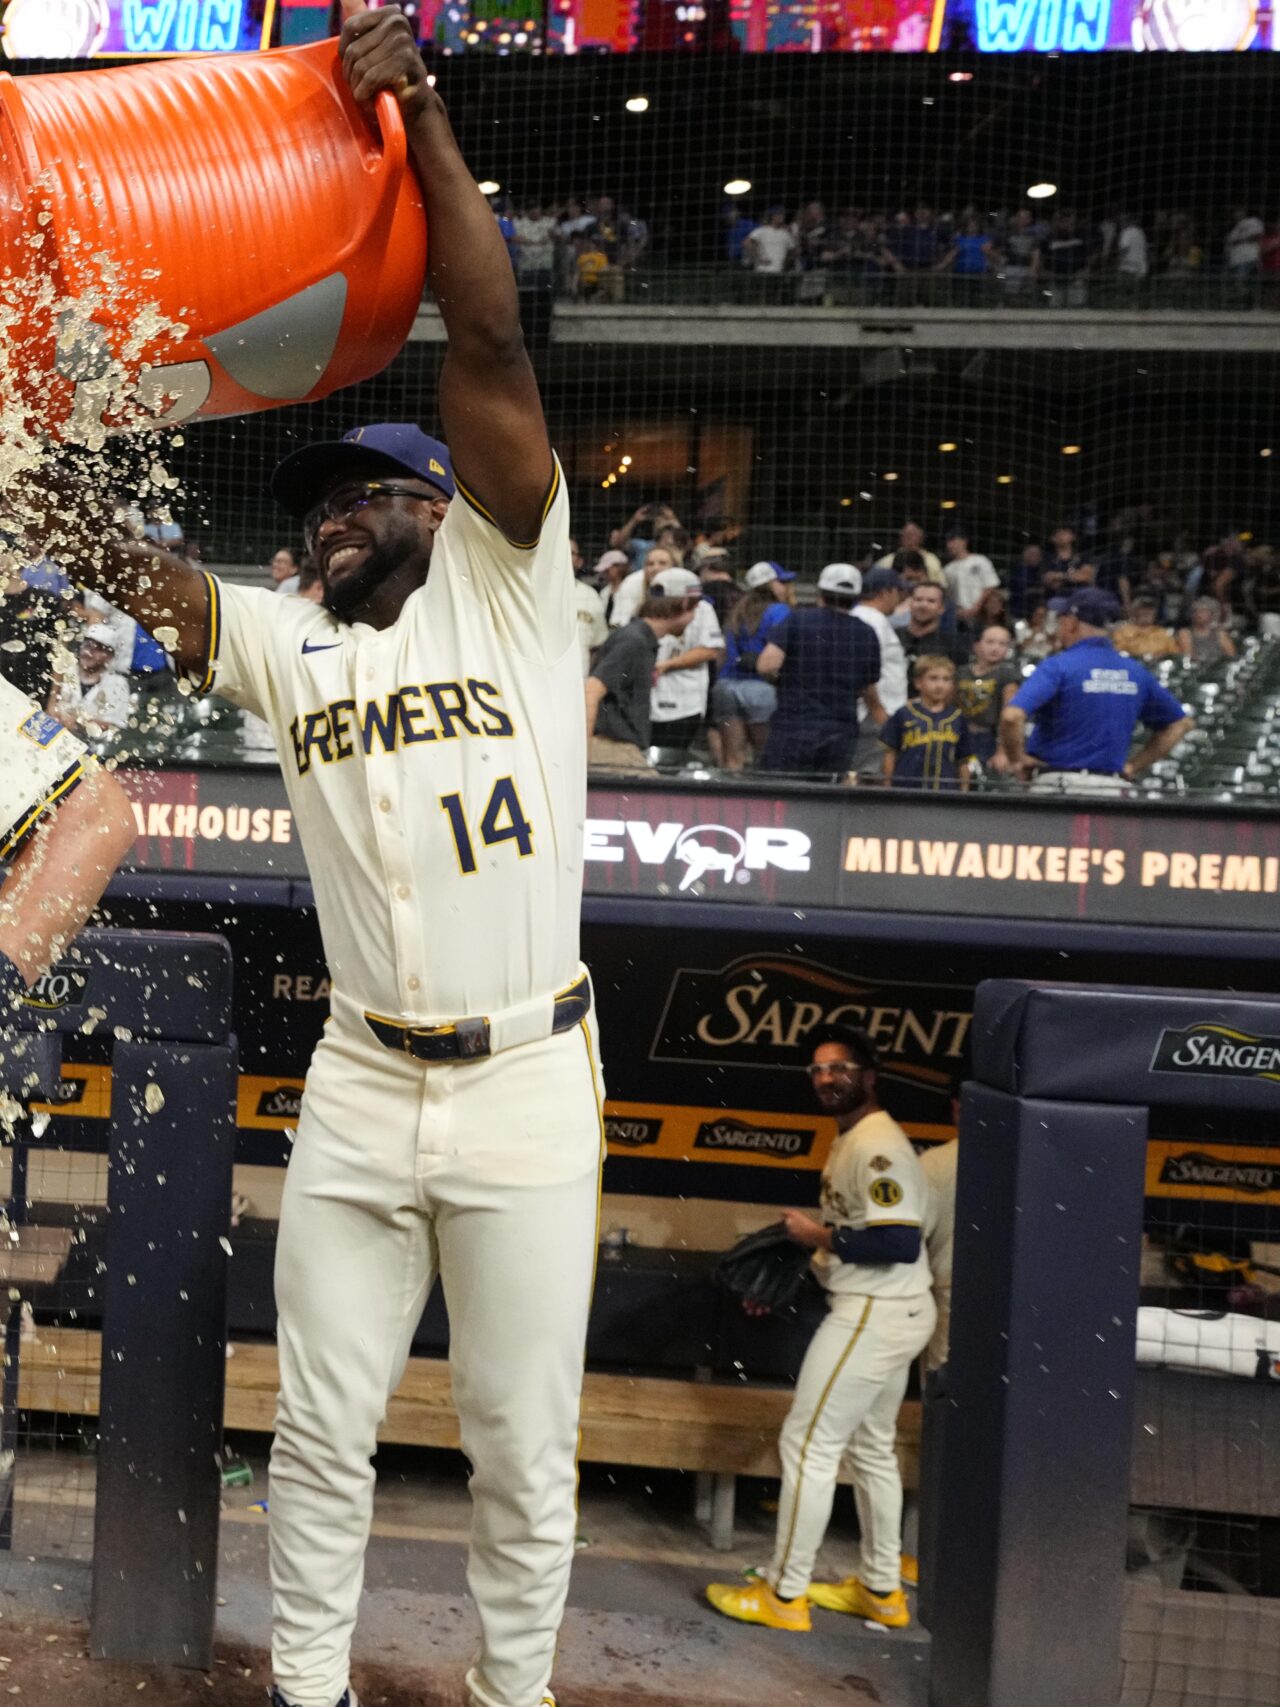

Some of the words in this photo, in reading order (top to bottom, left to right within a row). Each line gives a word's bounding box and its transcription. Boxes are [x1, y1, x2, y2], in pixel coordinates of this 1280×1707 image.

[122, 0, 243, 51] WIN
[975, 0, 1110, 51] WIN
[289, 677, 516, 777] BREWERS
[437, 774, 536, 877] 14
[844, 836, 1126, 886] MILWAUKEE'S
[1141, 851, 1280, 893] PREMI
[704, 1124, 803, 1153] SARGENTO
[1168, 1160, 1274, 1188] SARGENTO
